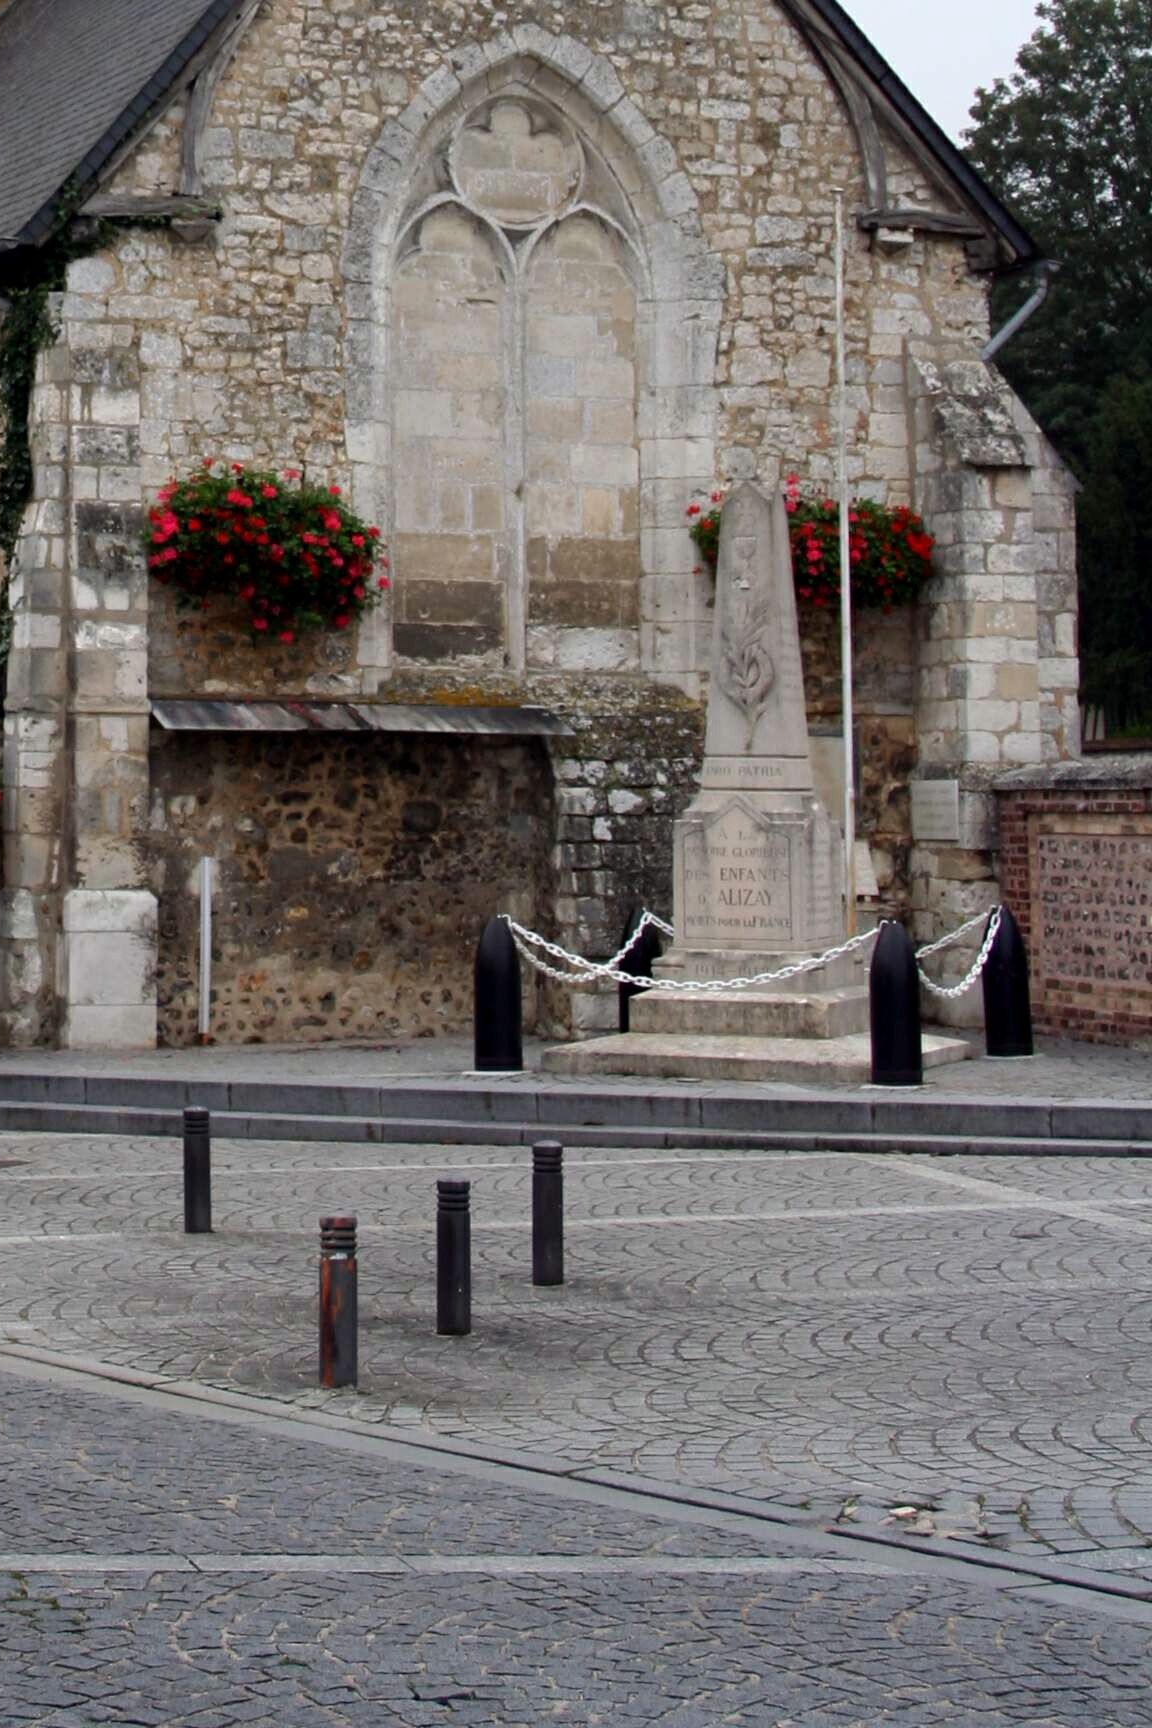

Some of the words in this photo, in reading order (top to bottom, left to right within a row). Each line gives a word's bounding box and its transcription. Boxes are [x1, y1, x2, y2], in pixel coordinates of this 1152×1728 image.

[738, 766, 783, 777] PATRIA
[719, 867, 789, 882] ENFANTS
[718, 889, 772, 906] ALIZAY
[752, 915, 792, 928] FRANCE
